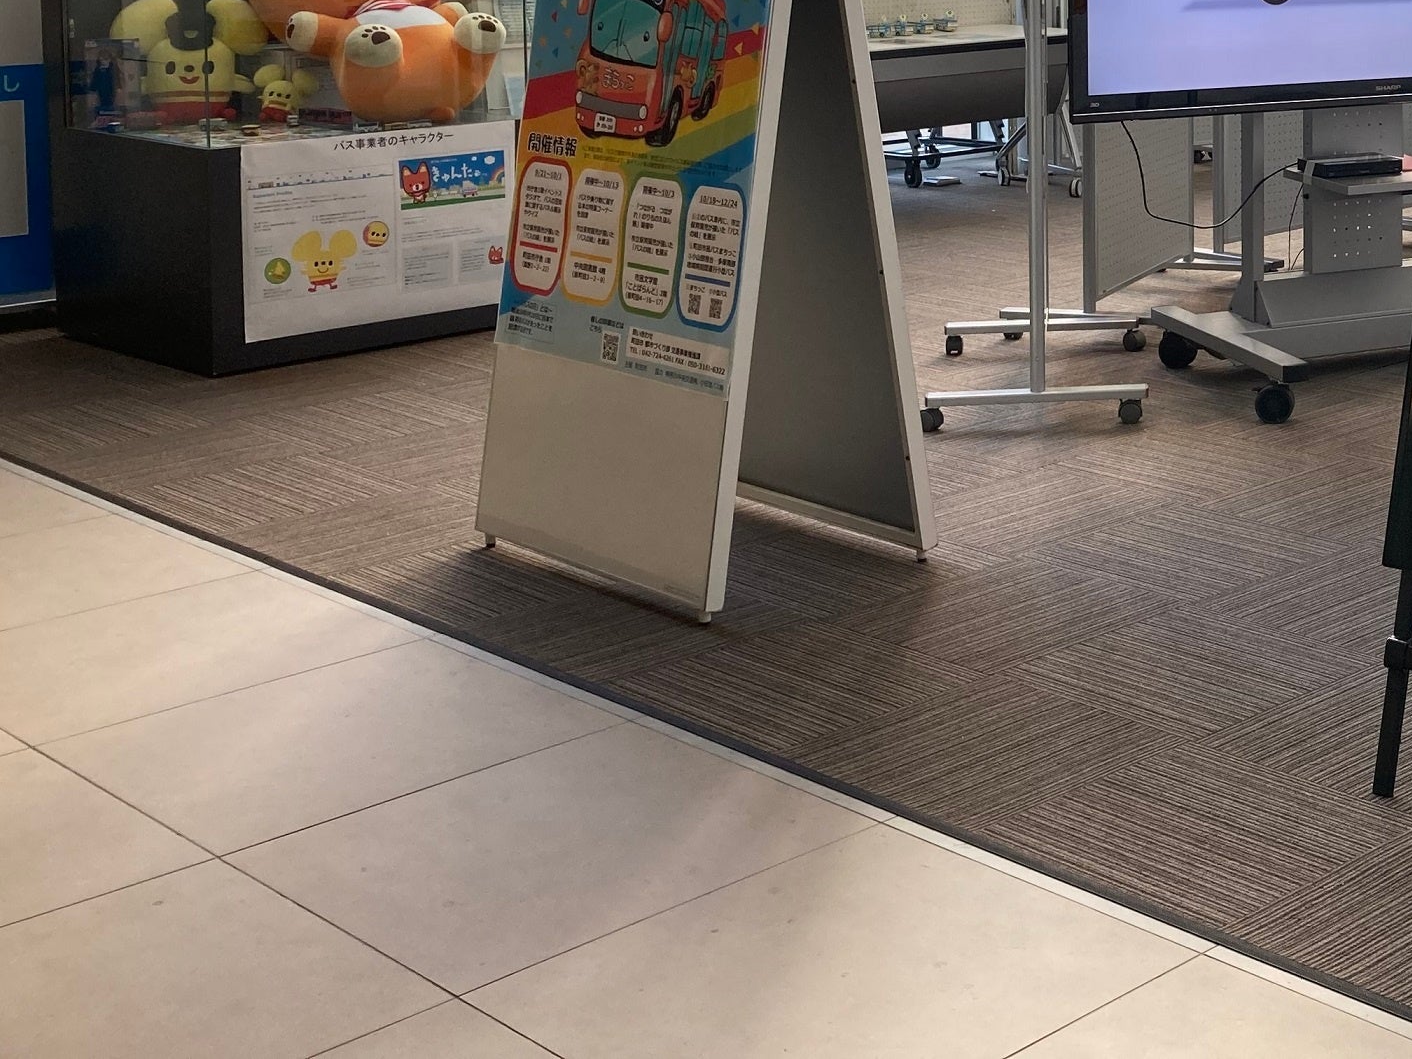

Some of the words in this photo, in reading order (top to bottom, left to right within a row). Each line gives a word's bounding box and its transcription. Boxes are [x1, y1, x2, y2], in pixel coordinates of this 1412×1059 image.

[333, 132, 454, 151] バス事業者のキャラクター
[527, 132, 578, 157] 開催情報
